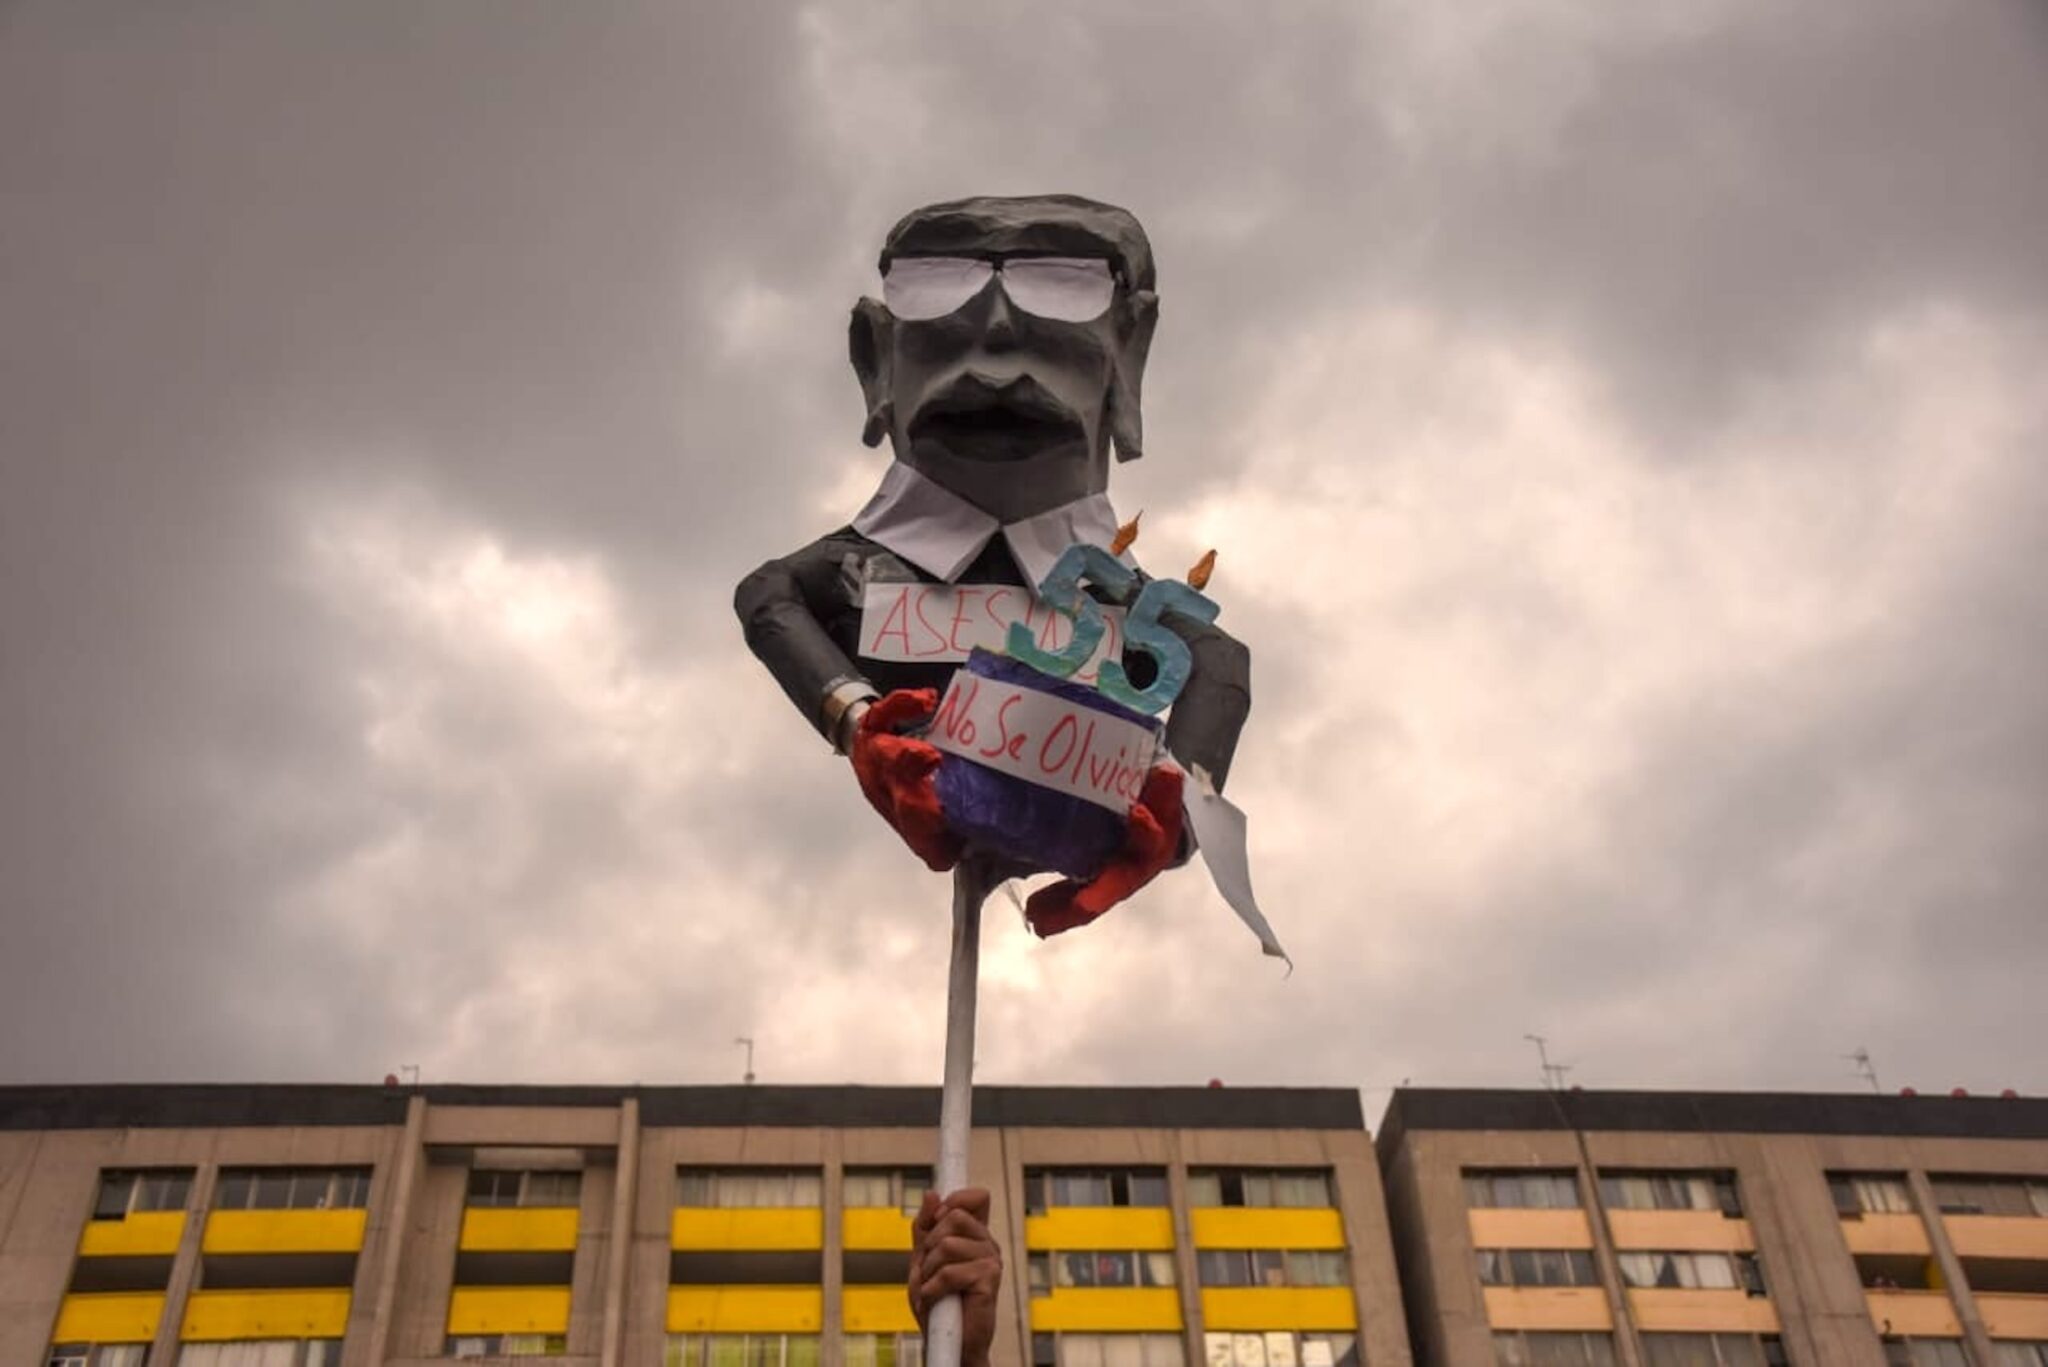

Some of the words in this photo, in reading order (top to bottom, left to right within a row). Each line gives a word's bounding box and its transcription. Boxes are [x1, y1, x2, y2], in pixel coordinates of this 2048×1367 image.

[1006, 544, 1221, 714] 55
[930, 686, 976, 746] No
[980, 693, 1029, 759] Se
